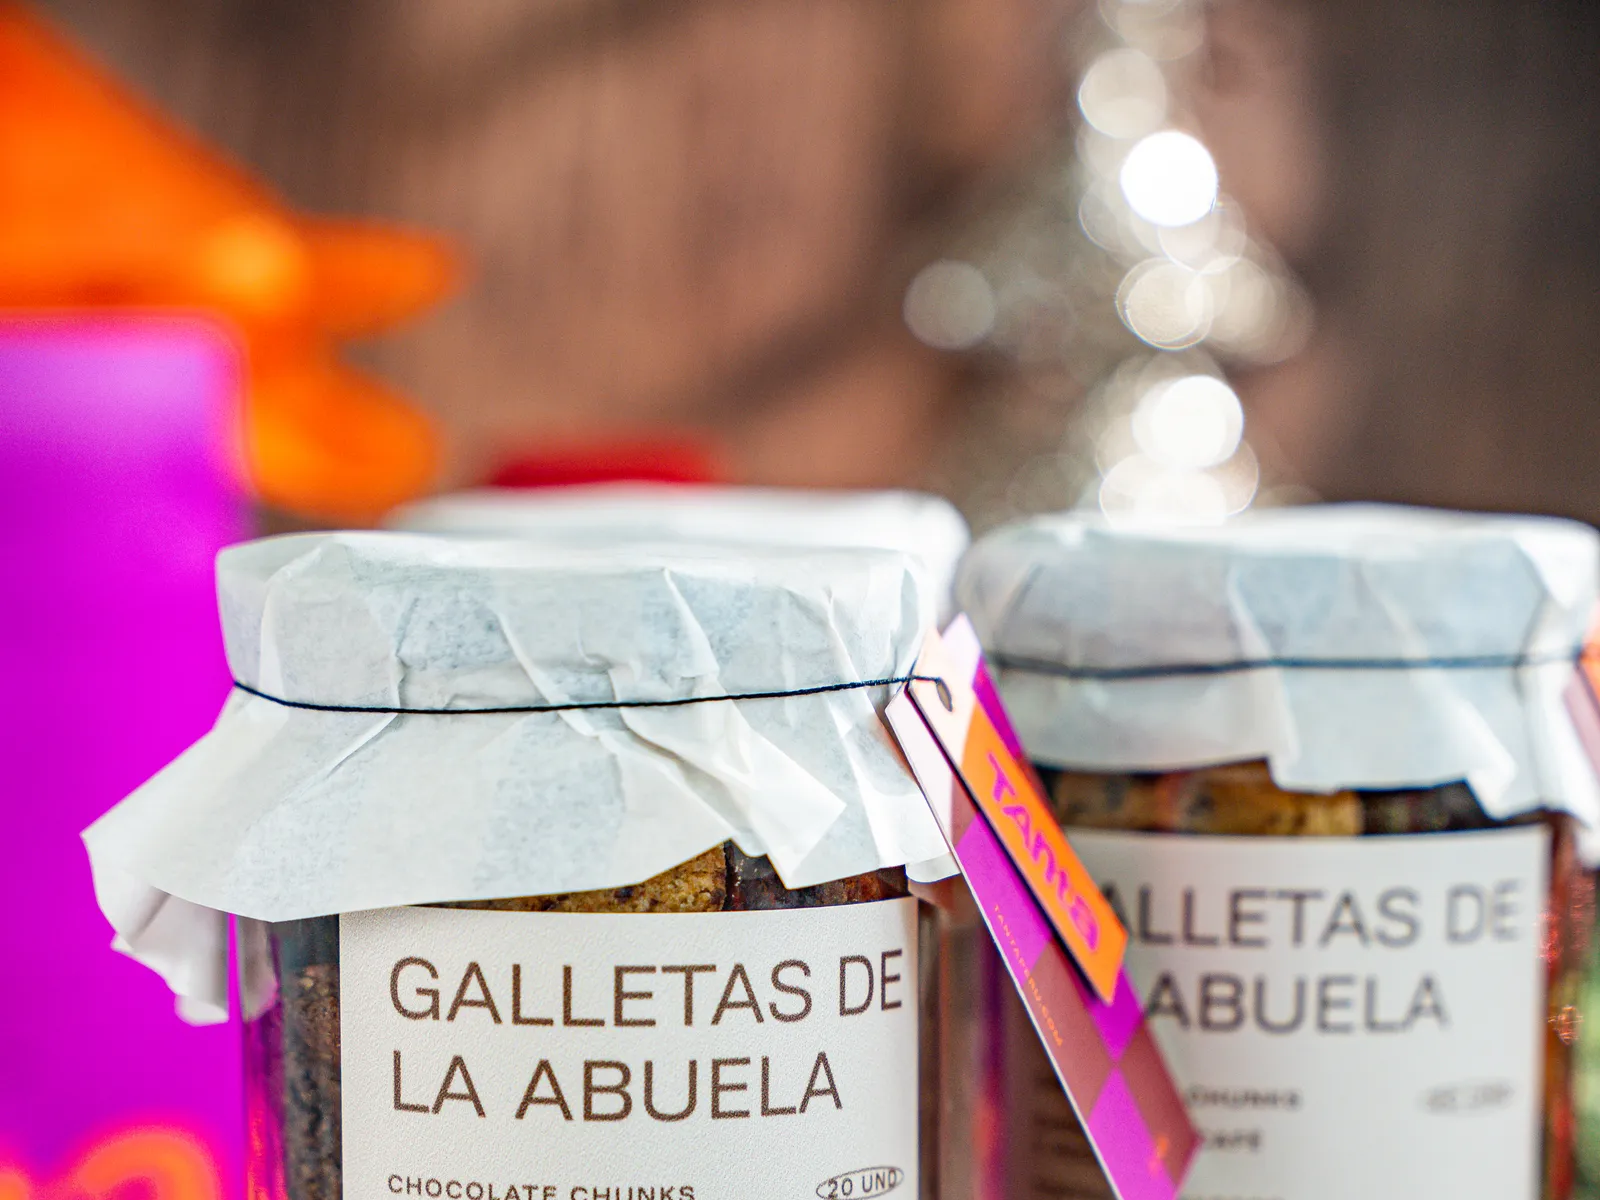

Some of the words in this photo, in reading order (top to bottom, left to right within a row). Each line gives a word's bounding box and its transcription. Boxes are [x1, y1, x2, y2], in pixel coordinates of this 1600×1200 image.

[987, 751, 1099, 953] TAnta
[1446, 879, 1521, 944] DE
[389, 956, 813, 1028] GALLETAS
[838, 948, 903, 1018] DE
[1145, 970, 1448, 1035] ABUELA
[393, 1050, 486, 1118] LA
[514, 1051, 843, 1123] ABUELA
[827, 1178, 853, 1200] 20
[862, 1168, 897, 1193] UND
